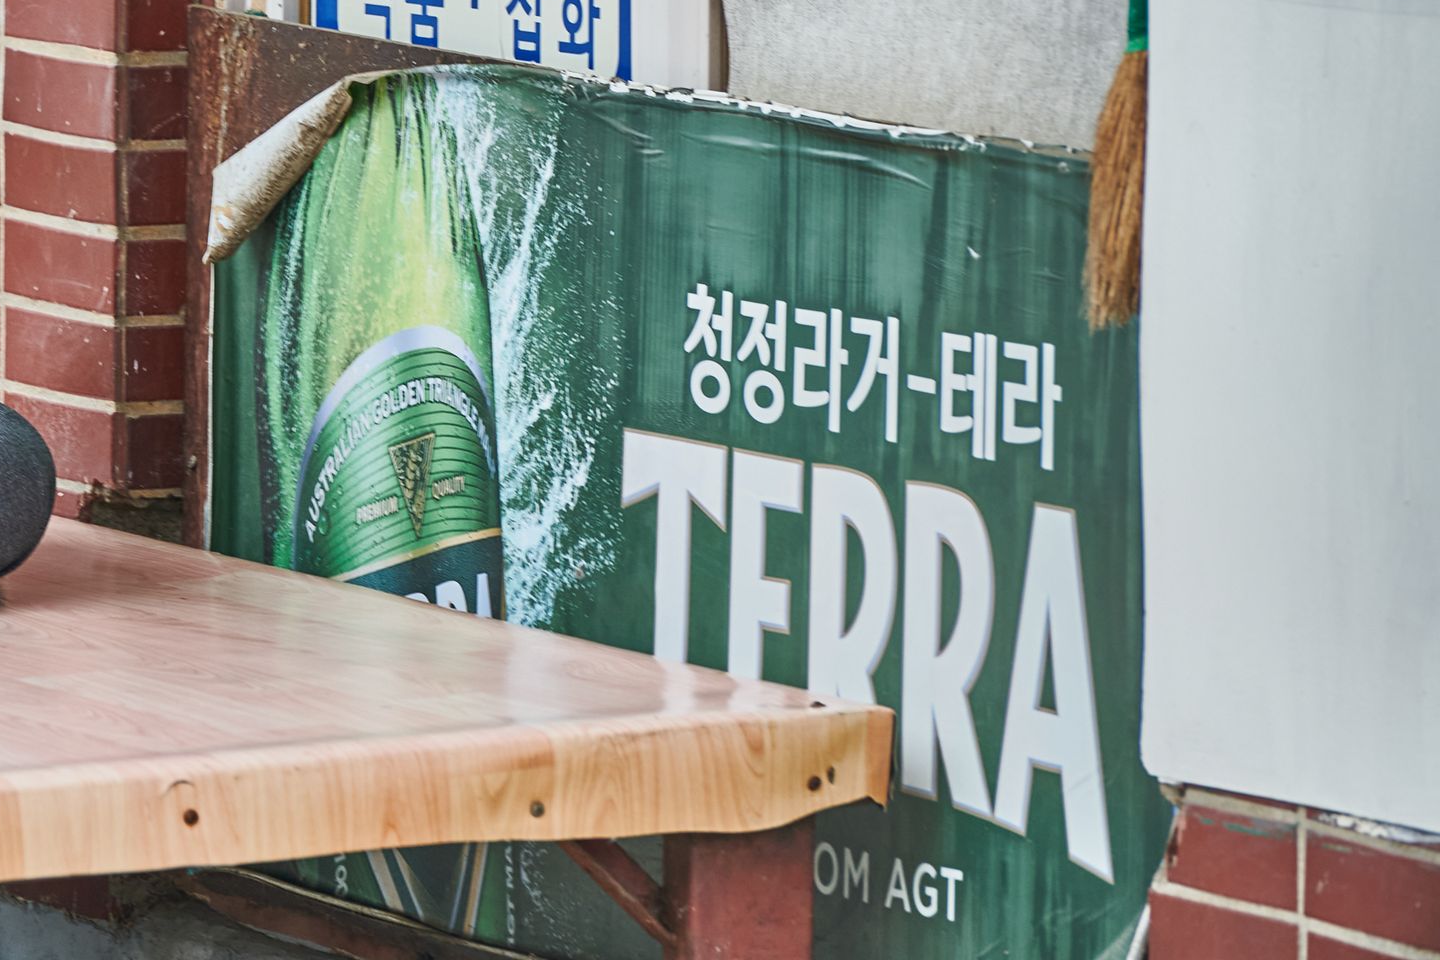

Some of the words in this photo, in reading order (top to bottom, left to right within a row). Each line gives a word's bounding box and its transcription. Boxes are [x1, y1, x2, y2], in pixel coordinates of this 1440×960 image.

[305, 413, 372, 543] AUSTRALIAN
[371, 378, 427, 426] GOLDEN
[426, 377, 479, 432] TRIANGLE
[620, 427, 1115, 885] TERRA
[884, 856, 964, 923] AGT
